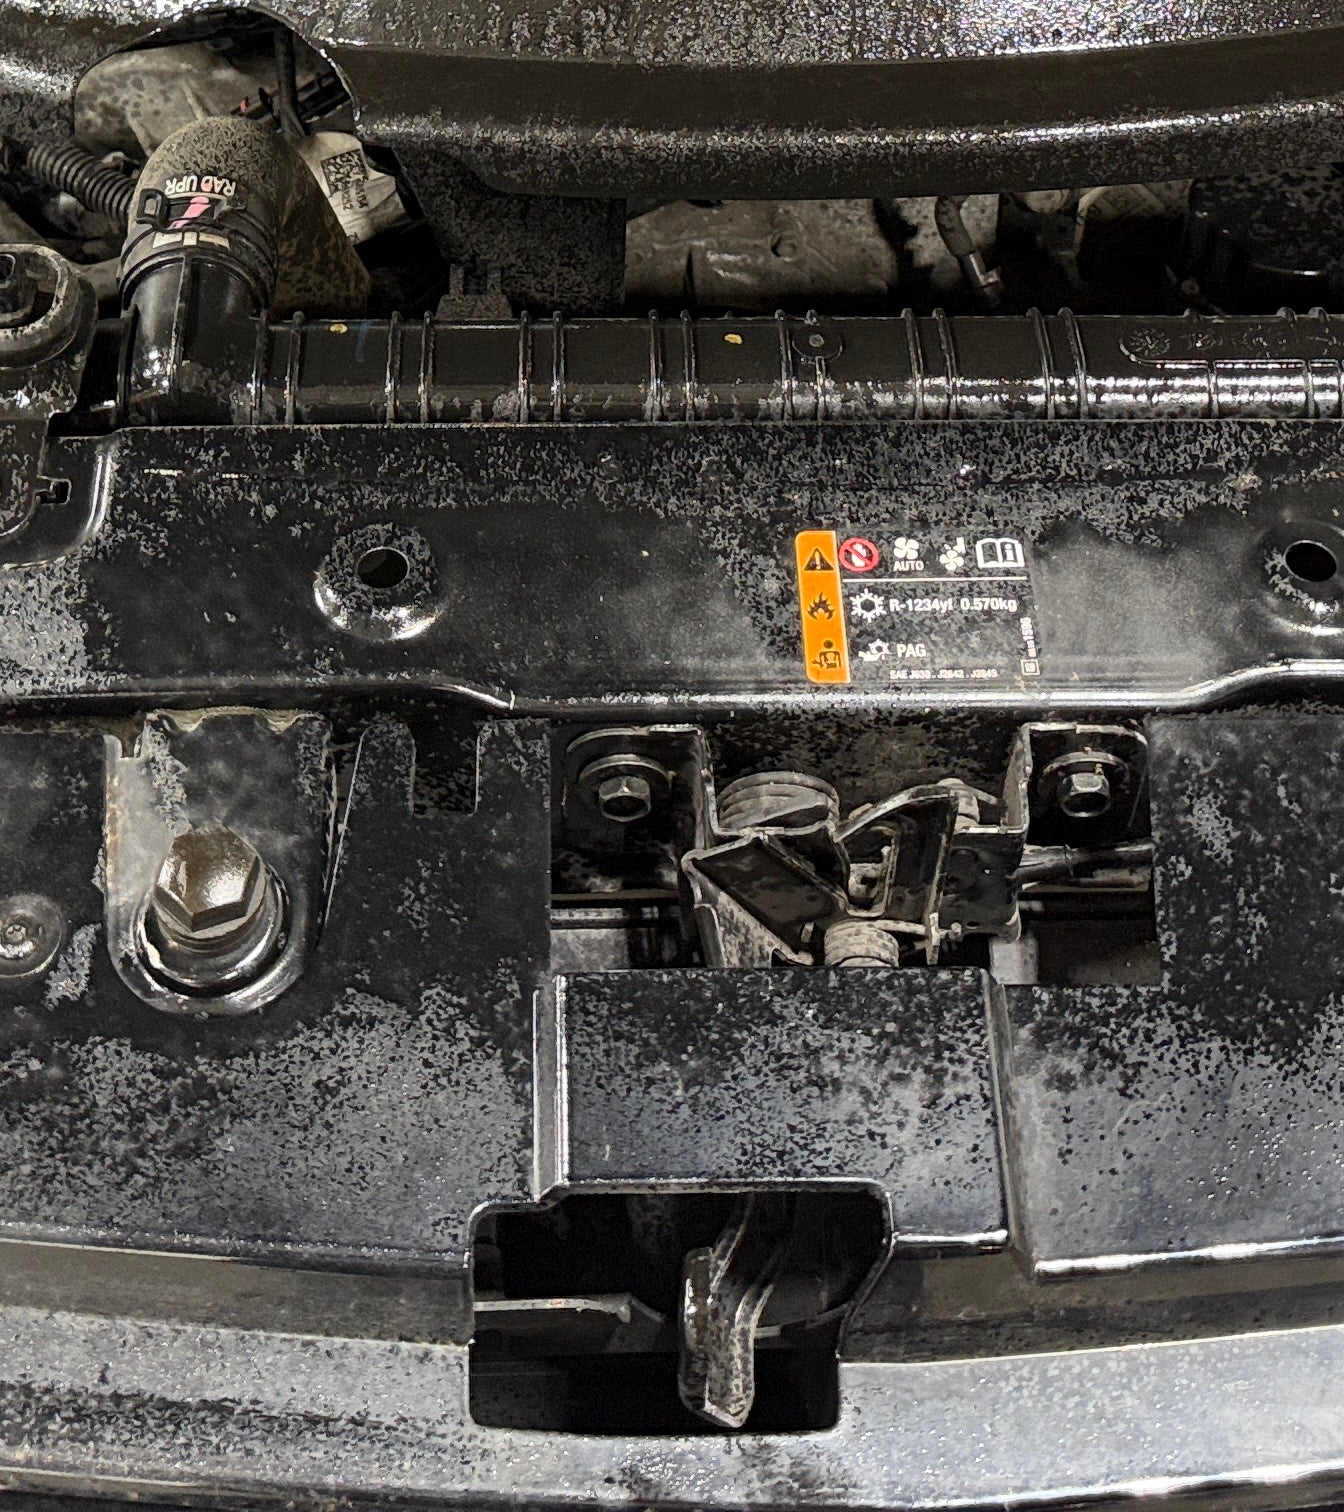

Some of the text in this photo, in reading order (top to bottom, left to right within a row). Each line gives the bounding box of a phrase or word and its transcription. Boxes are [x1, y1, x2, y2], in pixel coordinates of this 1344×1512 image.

[164, 175, 237, 197] RAD UPR
[892, 560, 925, 572] AUTO
[889, 597, 1018, 614] R-1234yf 0.570kg
[896, 643, 928, 658] PAG
[889, 669, 908, 680] SAE
